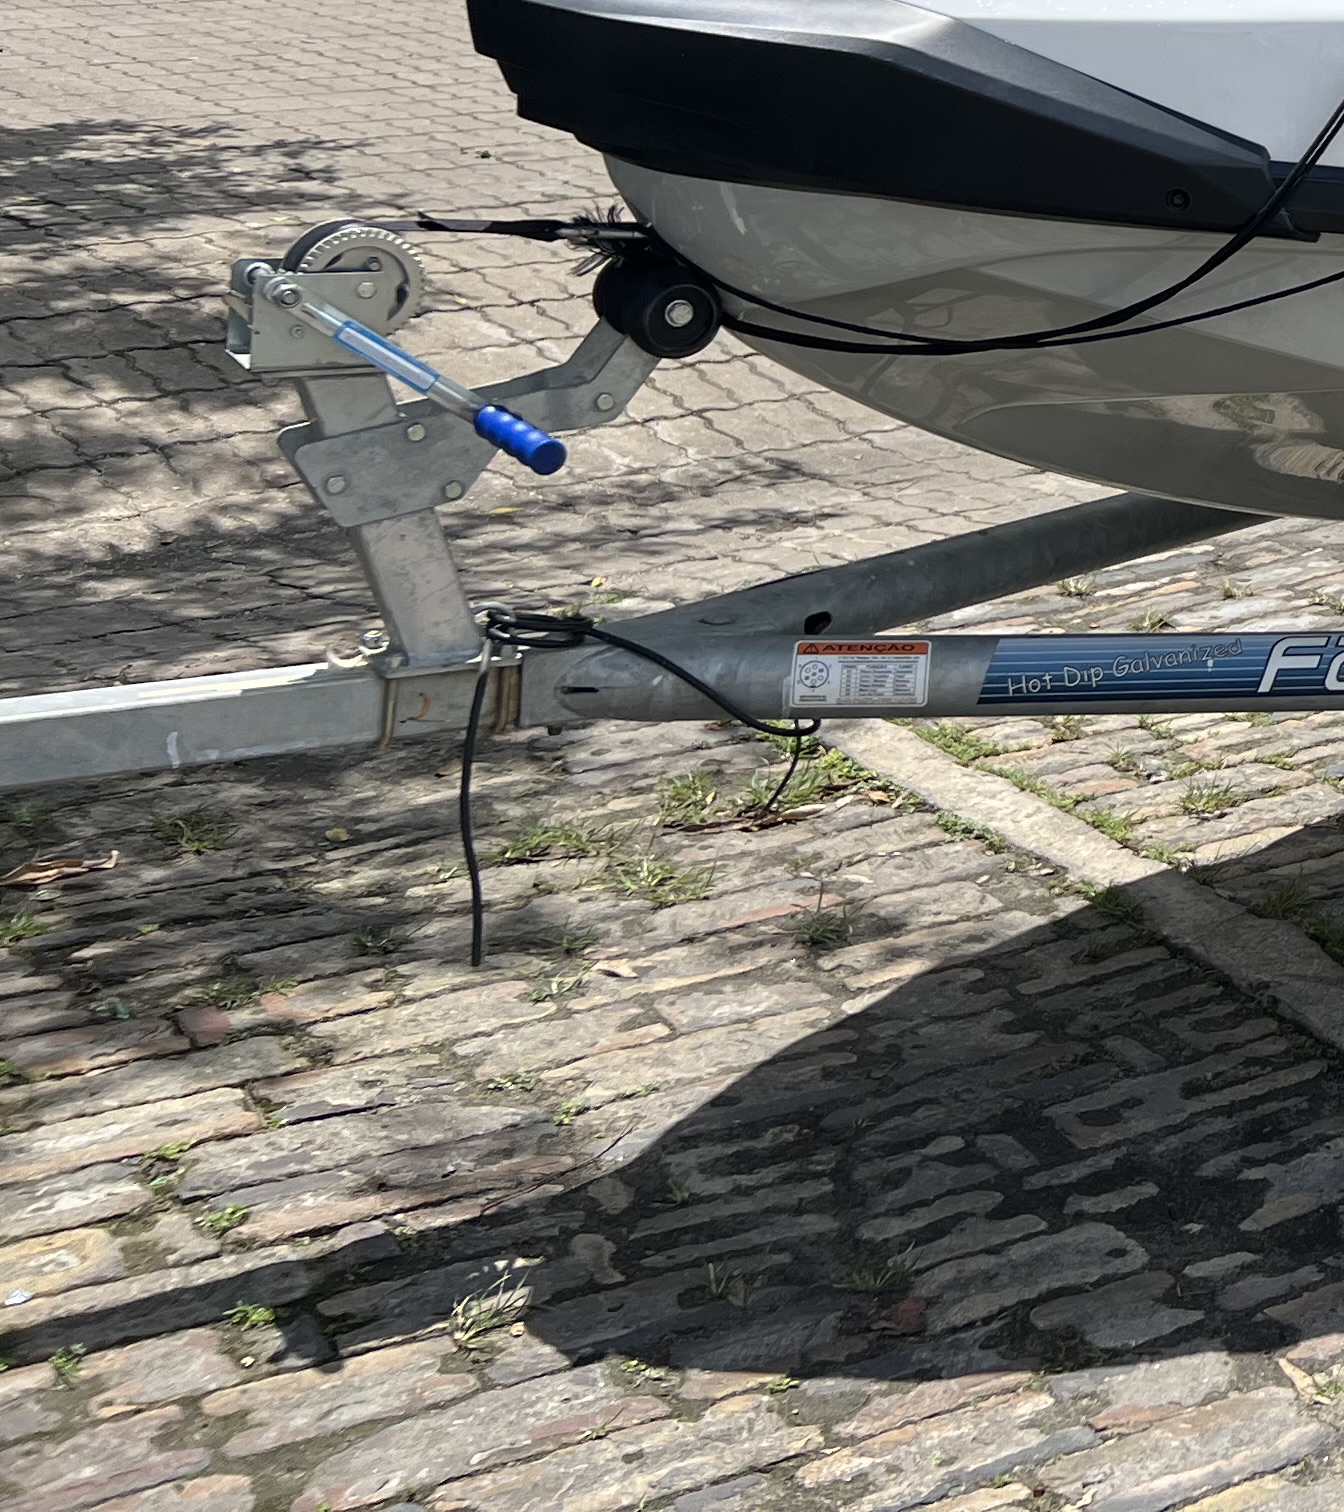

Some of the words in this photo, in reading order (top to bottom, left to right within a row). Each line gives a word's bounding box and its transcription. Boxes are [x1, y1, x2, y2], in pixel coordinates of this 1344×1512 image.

[822, 642, 916, 654] ATENÇÃO
[1007, 672, 1054, 696] Hot
[1063, 663, 1104, 688] Dip
[1112, 638, 1243, 678] Galvanized
